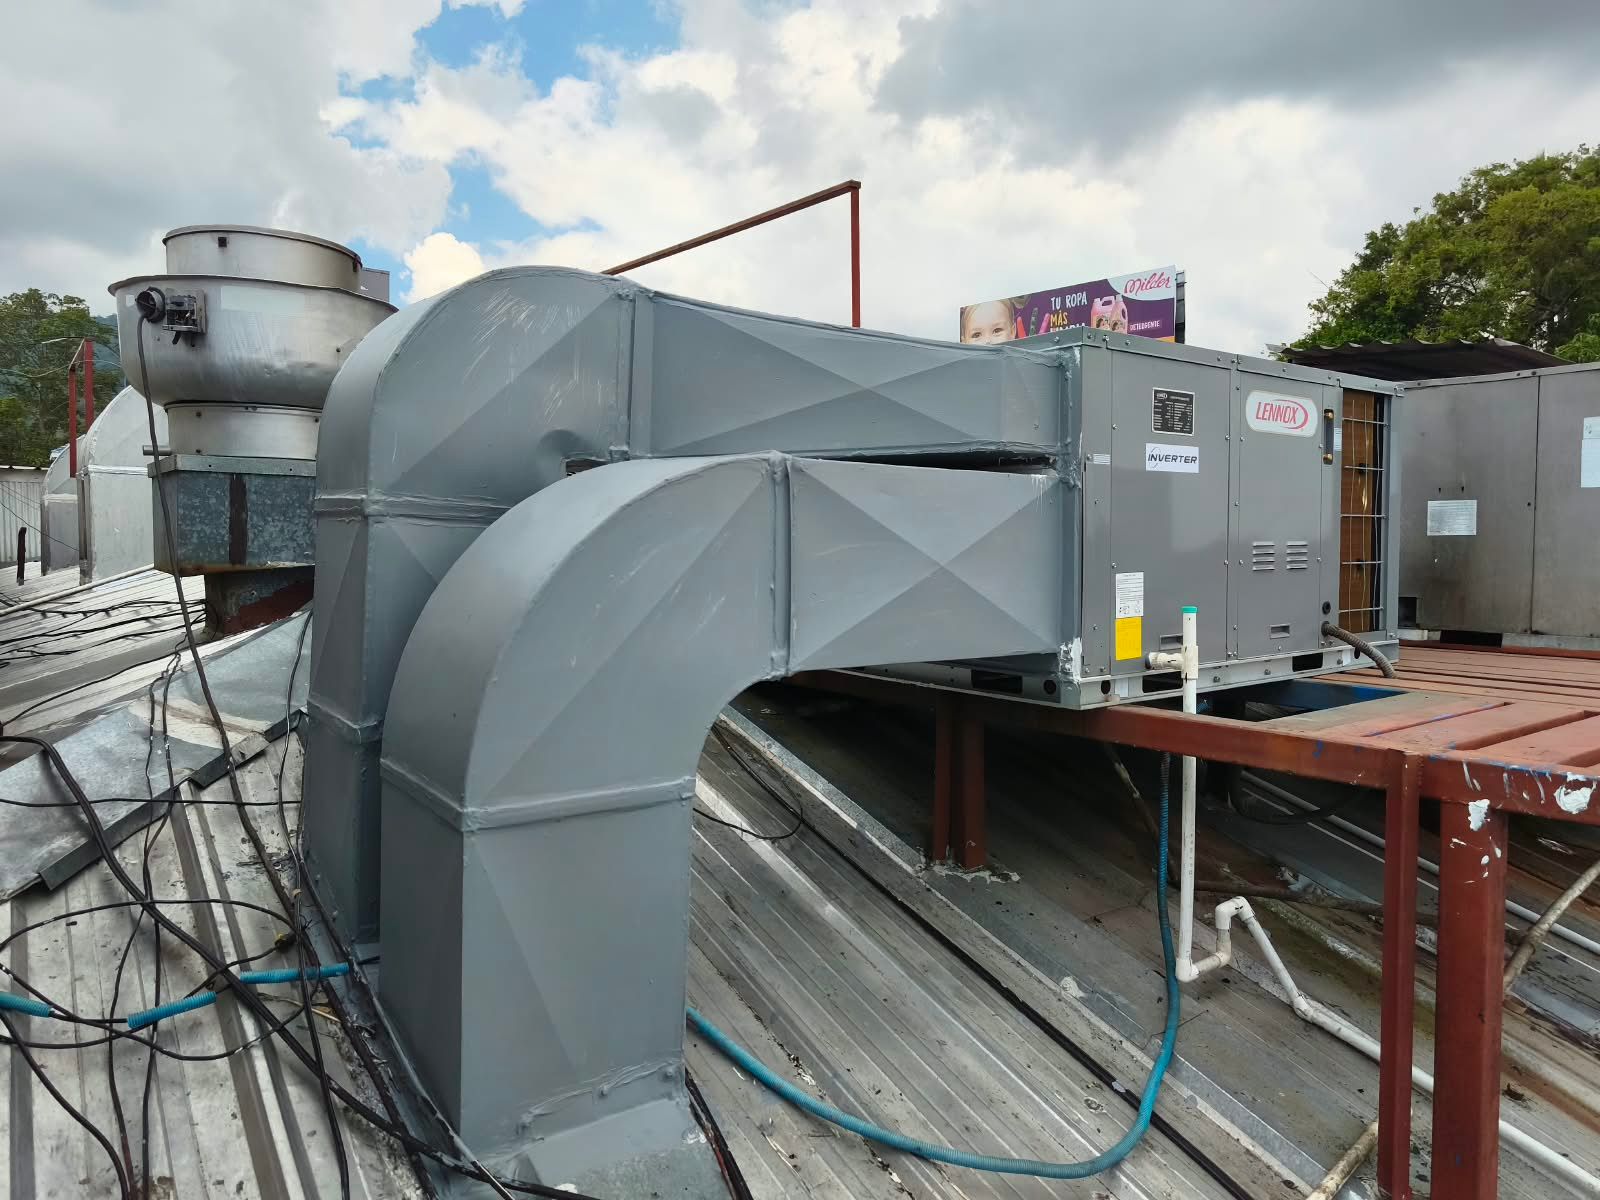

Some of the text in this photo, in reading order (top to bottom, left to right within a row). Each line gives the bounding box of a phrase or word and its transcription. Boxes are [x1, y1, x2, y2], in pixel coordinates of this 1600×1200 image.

[1051, 291, 1087, 310] TU ROPA
[1050, 310, 1068, 327] MÁS
[1129, 320, 1160, 331] DETERGENTE
[1256, 402, 1298, 424] LENNOX
[1148, 454, 1198, 464] INVERTER
